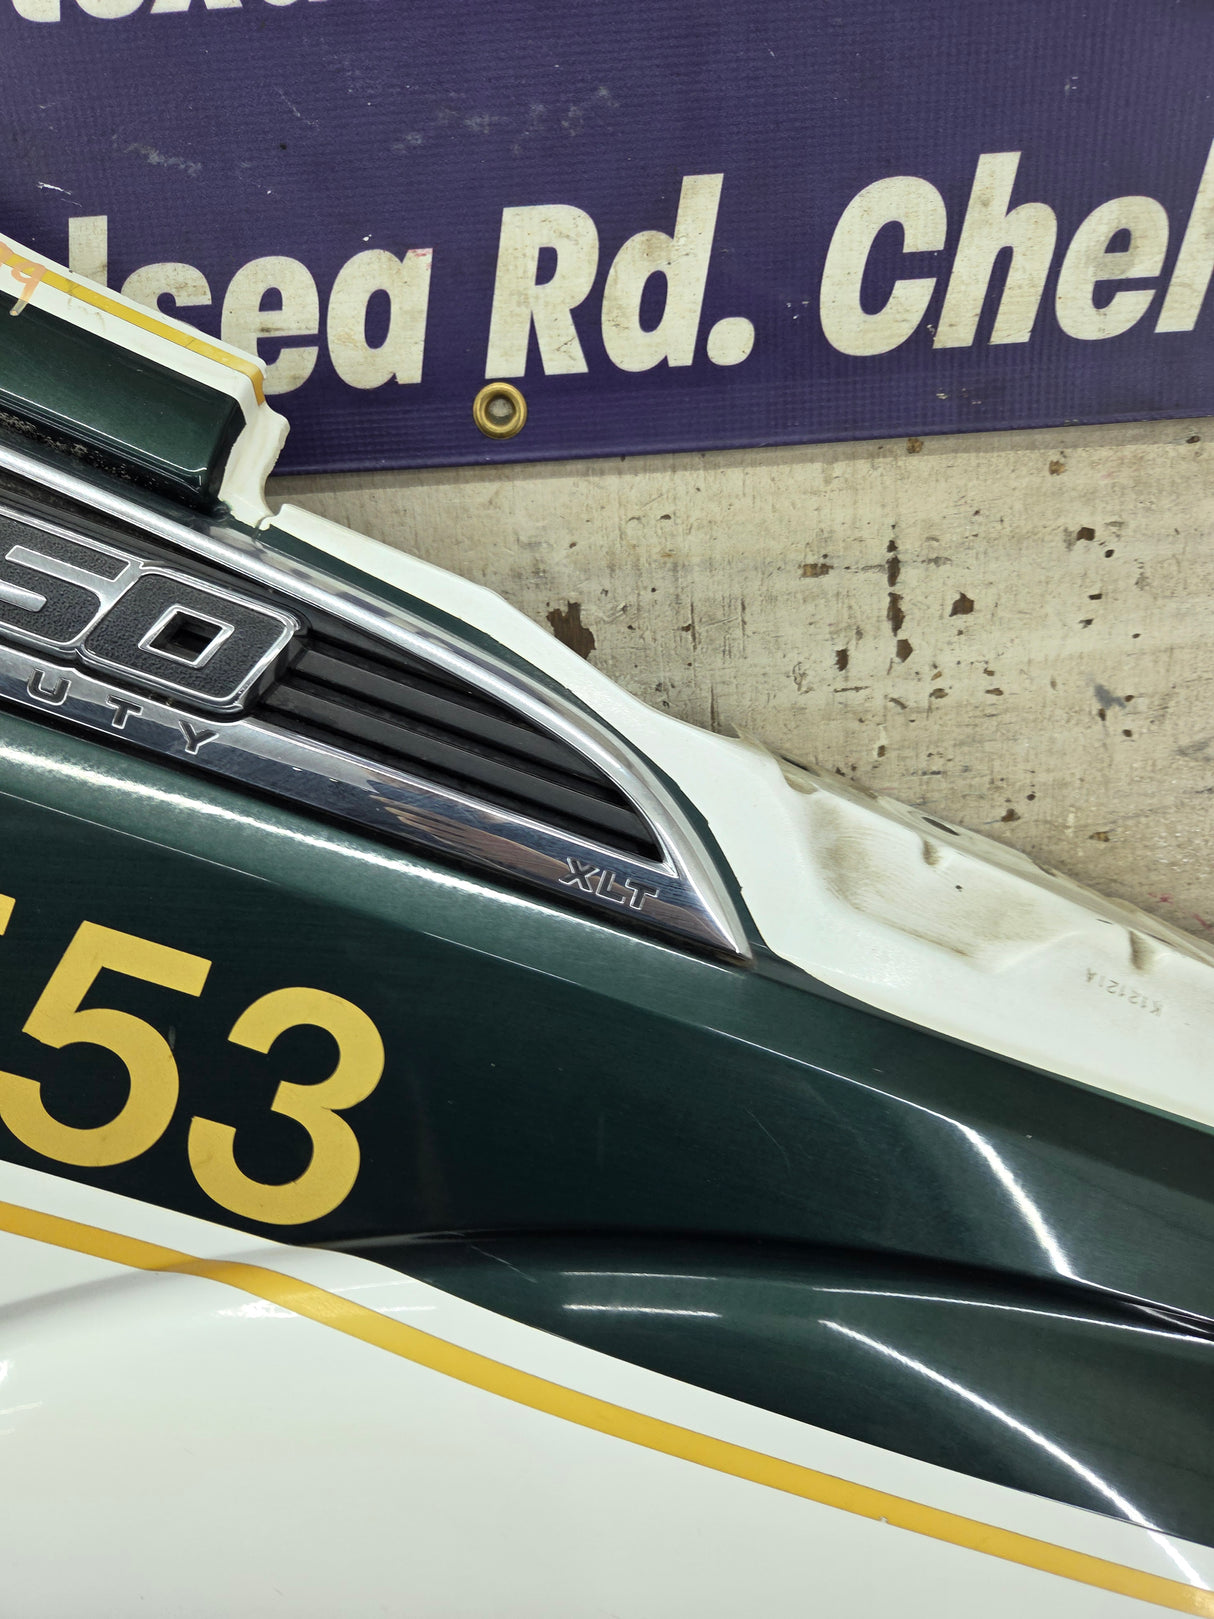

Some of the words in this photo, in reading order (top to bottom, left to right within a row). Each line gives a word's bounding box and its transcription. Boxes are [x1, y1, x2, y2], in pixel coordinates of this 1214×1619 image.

[485, 173, 755, 378] Rd.
[820, 138, 1214, 357] Chel
[27, 668, 219, 755] UTY
[558, 857, 660, 910] XLT
[0, 893, 385, 1225] 53
